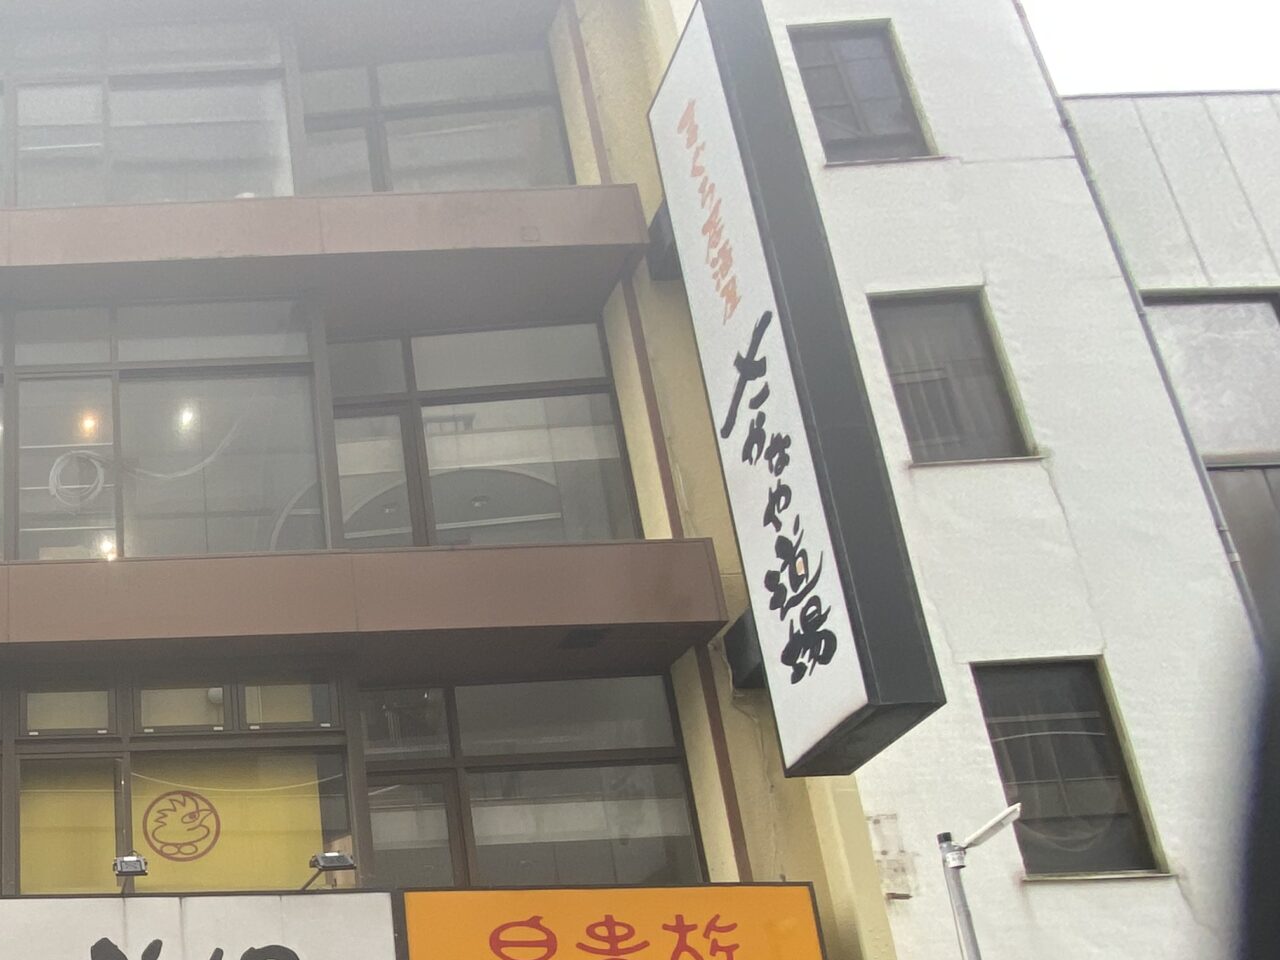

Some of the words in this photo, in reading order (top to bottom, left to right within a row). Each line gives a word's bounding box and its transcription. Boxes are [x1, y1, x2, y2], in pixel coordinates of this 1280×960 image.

[720, 311, 838, 684] さかなや道場
